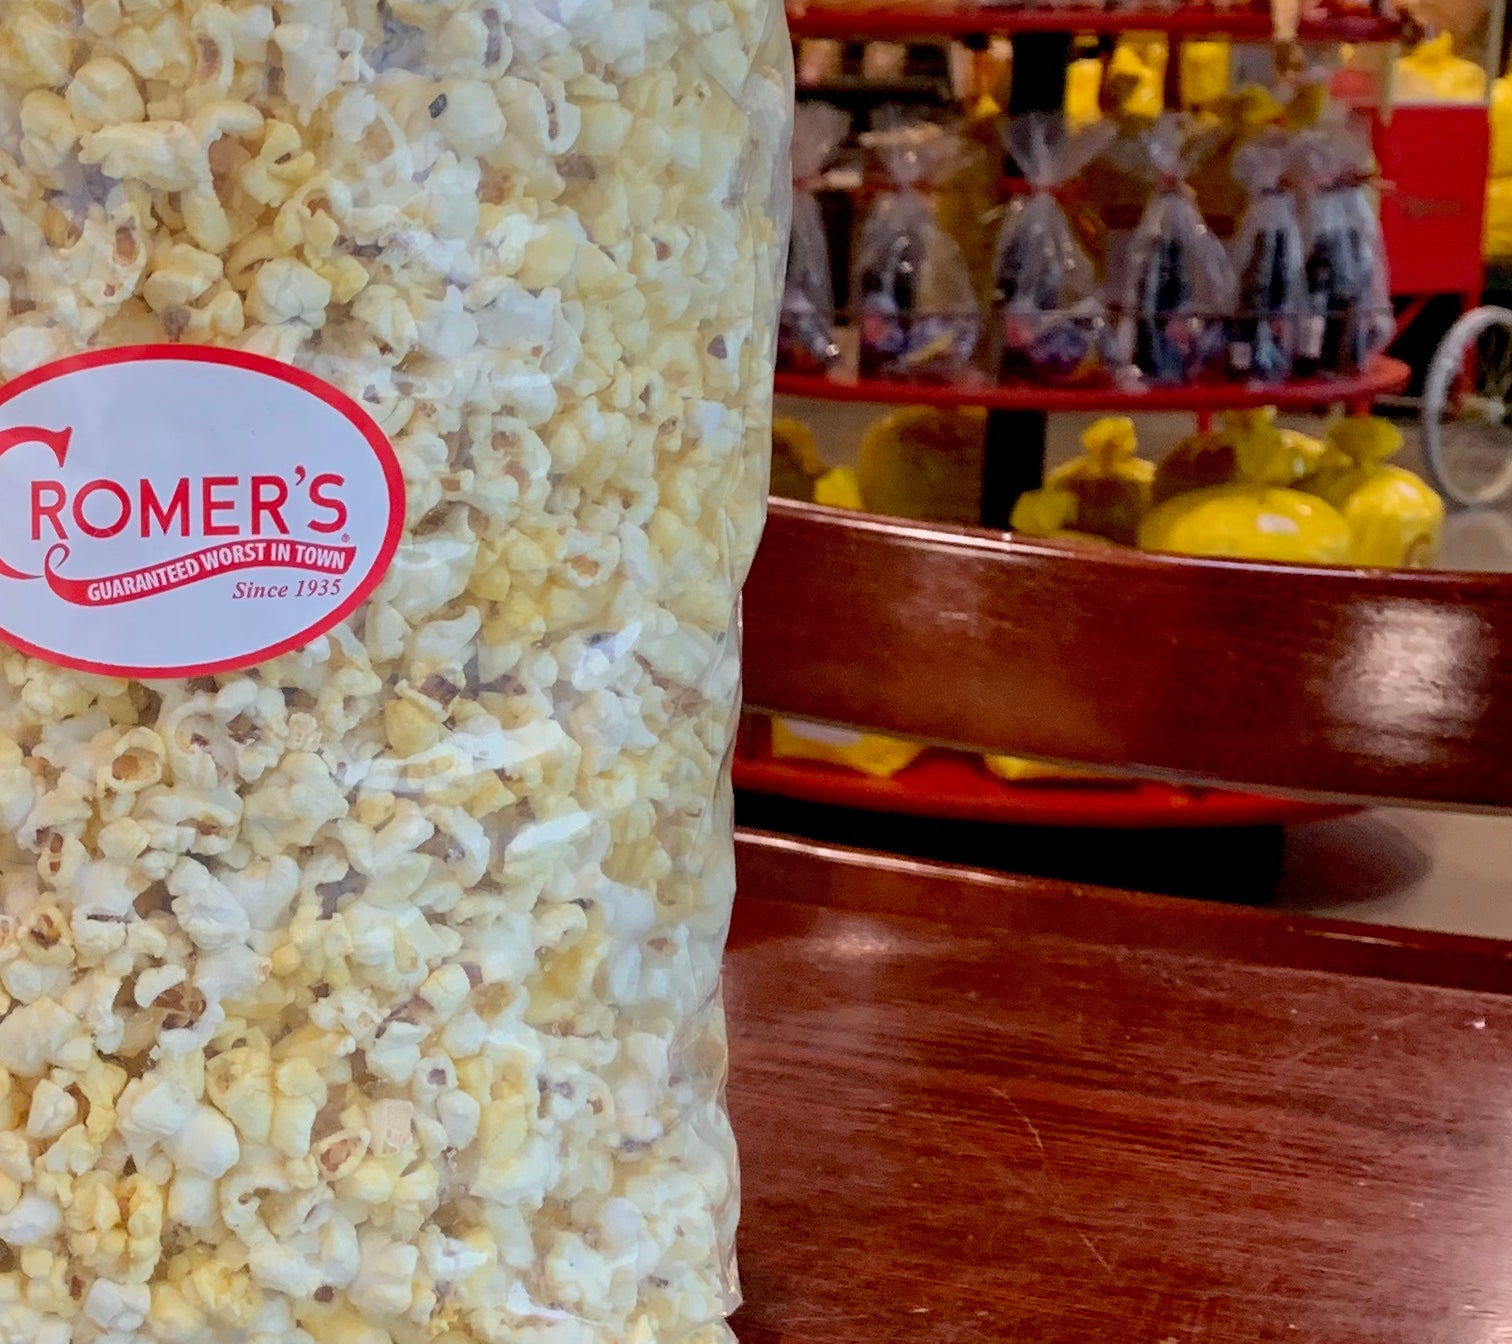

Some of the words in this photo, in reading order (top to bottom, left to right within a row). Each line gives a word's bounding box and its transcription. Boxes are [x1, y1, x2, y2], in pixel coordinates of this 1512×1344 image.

[87, 559, 199, 602] GUARANTEED
[201, 542, 267, 570] WORST
[270, 542, 290, 562] IN
[295, 545, 346, 570] TOWN
[232, 581, 288, 600] Since
[294, 578, 341, 598] 1935
